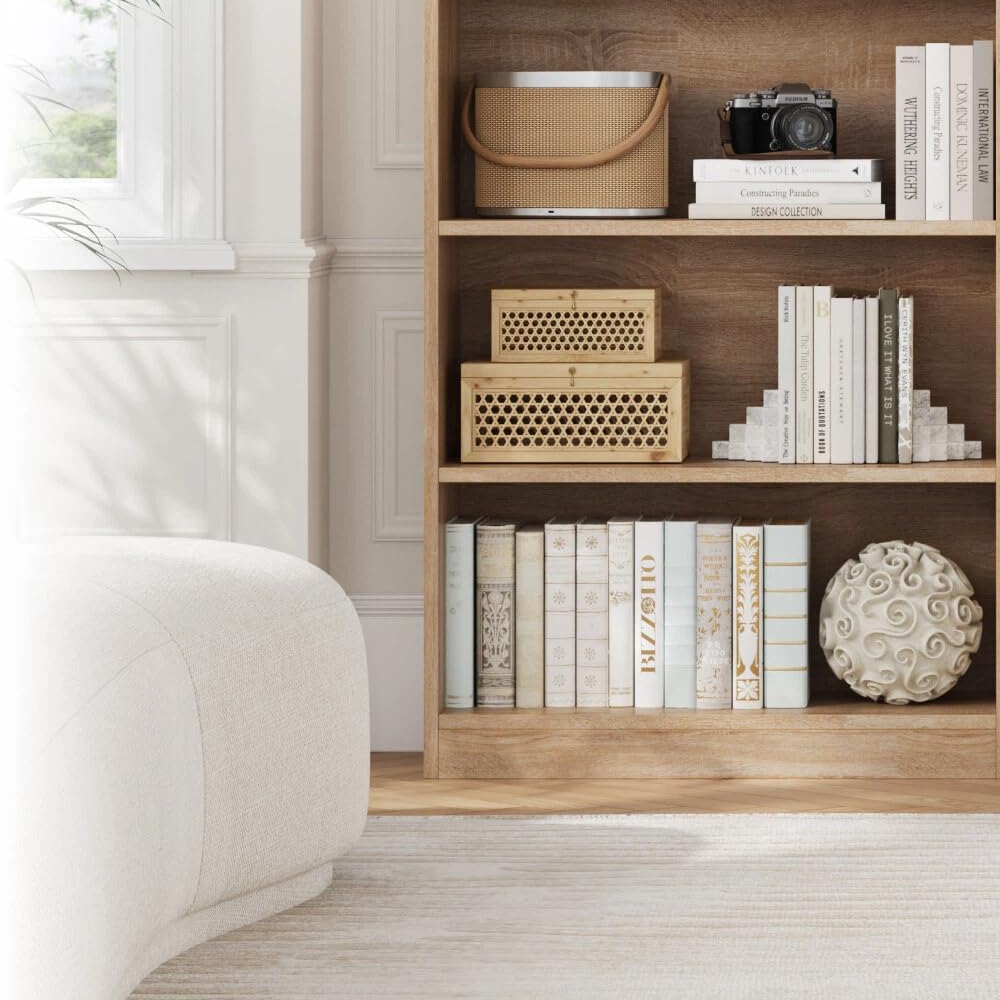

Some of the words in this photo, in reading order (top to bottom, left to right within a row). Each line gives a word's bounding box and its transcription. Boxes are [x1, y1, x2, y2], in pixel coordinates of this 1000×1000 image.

[931, 86, 943, 130] Constructing
[956, 83, 968, 131] DOMINIC
[904, 97, 917, 155] WUTHERING
[978, 88, 989, 160] INTERNATIONAL
[745, 167, 800, 176] KINFOLK
[904, 160, 917, 200] HEIGHTS
[978, 164, 989, 183] LAW
[740, 189, 787, 198] Constructing
[751, 207, 777, 216] DESIGN
[780, 207, 822, 216] COLLECTION
[800, 335, 809, 349] The
[798, 351, 809, 370] Tulip
[884, 351, 892, 363] IT
[800, 372, 809, 402] Garden
[884, 366, 892, 392] WHAT
[884, 396, 892, 409] IS
[884, 414, 892, 426] IT
[818, 427, 825, 437] OF
